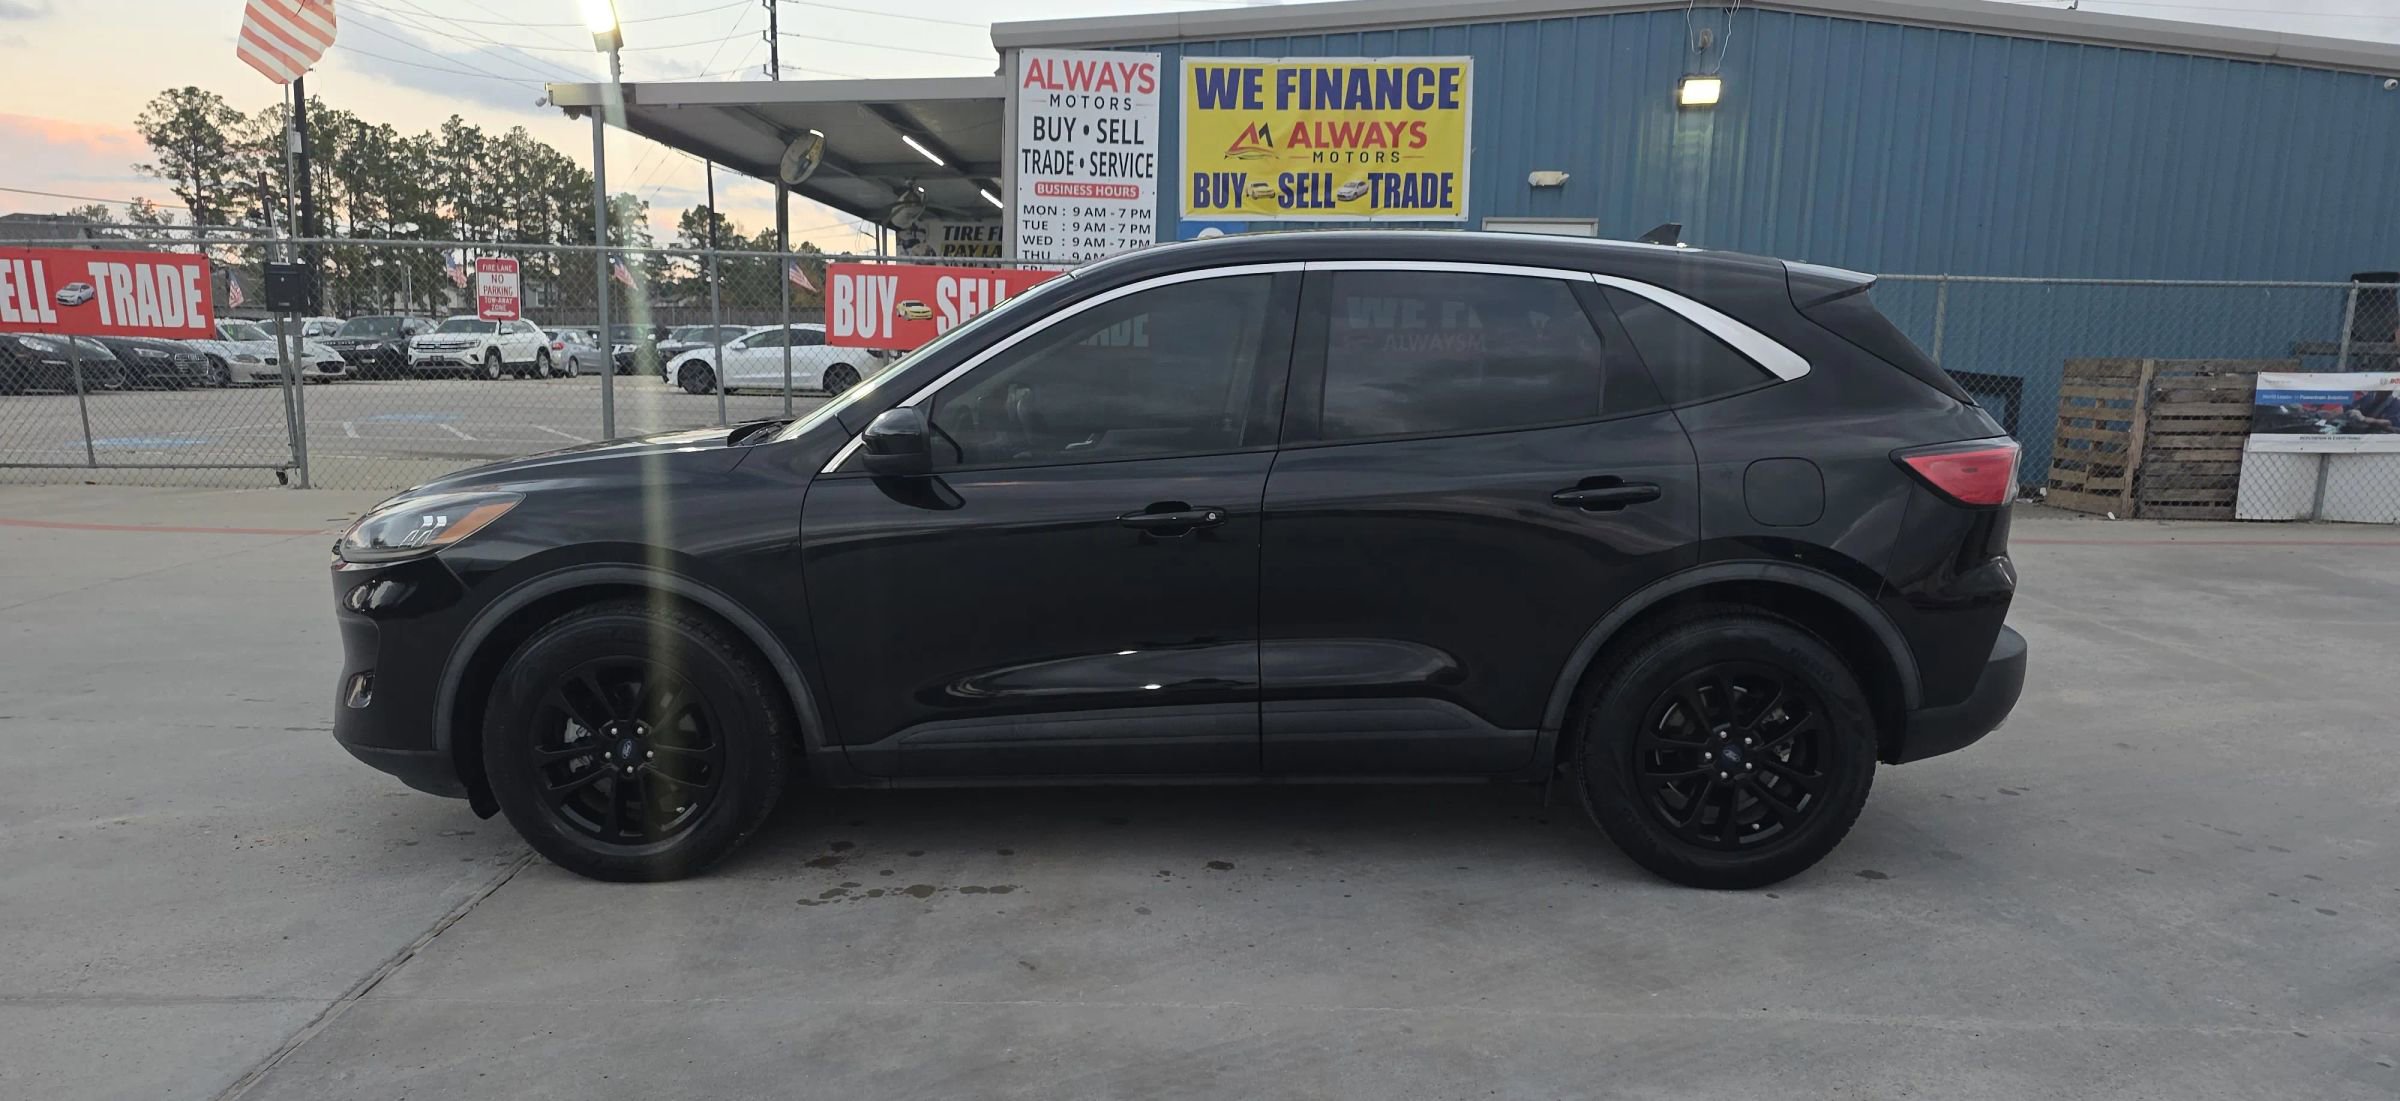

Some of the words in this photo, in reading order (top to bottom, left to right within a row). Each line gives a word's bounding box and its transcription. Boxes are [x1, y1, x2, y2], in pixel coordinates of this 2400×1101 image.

[1023, 58, 1156, 95] ALWAYS
[1194, 67, 1264, 110] WE
[1276, 67, 1460, 110] FINANCE
[1049, 93, 1132, 111] MOTORS
[1033, 115, 1077, 143] BUY
[1096, 118, 1145, 145] SELL
[1287, 120, 1428, 149] ALWAYS
[1021, 148, 1075, 176] TRADE
[1089, 151, 1154, 179] SERVICE
[1312, 151, 1400, 163] MOTORS
[1037, 183, 1093, 196] BUSINESS
[1095, 186, 1137, 198] HOURS
[1193, 172, 1248, 209] BUY
[1277, 172, 1336, 209] SELL
[1367, 172, 1454, 209] TRADE
[1023, 204, 1057, 216] MON
[1072, 206, 1080, 217] 9
[1084, 207, 1106, 218] AM
[1119, 208, 1127, 218] 7
[1130, 209, 1151, 219] PM
[943, 225, 985, 241] TIRE
[1022, 220, 1048, 231] TUE
[1072, 222, 1080, 232] 9
[1083, 222, 1106, 233] AM
[1118, 223, 1126, 234] 7
[1130, 224, 1151, 235] PM
[943, 243, 978, 257] PAY
[1022, 235, 1053, 246] WED
[1072, 237, 1080, 247] 9
[1083, 237, 1106, 248] AM
[1117, 239, 1126, 249] 7
[1129, 239, 1150, 249] PM
[1021, 250, 1051, 260] THU
[1072, 252, 1080, 260] 9
[497, 264, 513, 272] LANE
[491, 274, 504, 284] NO
[87, 261, 206, 329] TRADE
[483, 285, 513, 296] PARKING
[834, 274, 898, 339] BUY
[1347, 296, 1426, 329] WE
